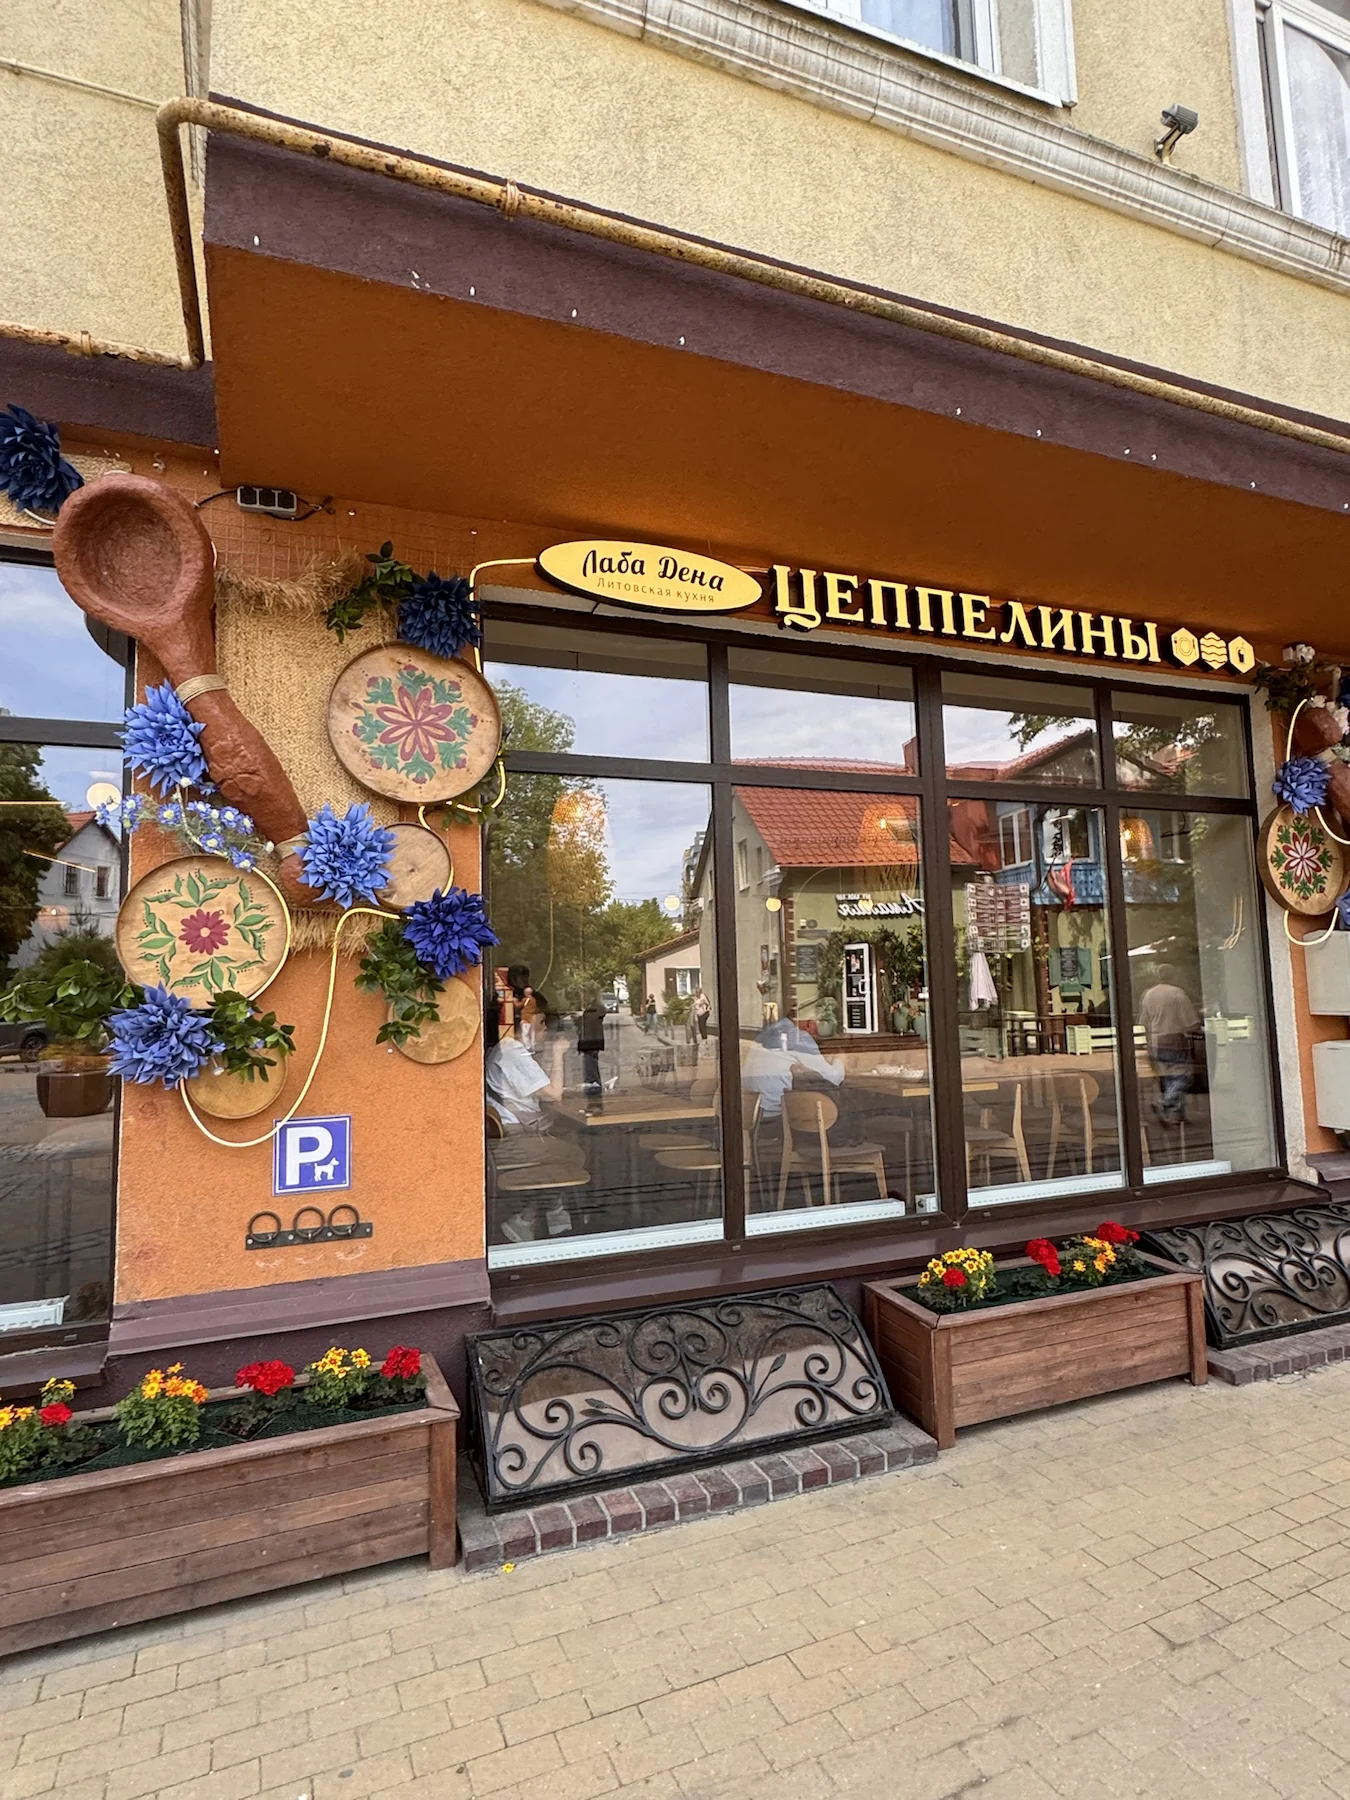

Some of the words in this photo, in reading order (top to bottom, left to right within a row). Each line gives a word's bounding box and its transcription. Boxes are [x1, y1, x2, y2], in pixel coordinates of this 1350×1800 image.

[582, 549, 645, 578] Лаба
[658, 555, 724, 592] Дена
[597, 577, 672, 598] Литовская
[676, 589, 715, 603] кухня
[772, 563, 1162, 663] ЦЕППЕЛИНЫ
[285, 1125, 333, 1186] P
